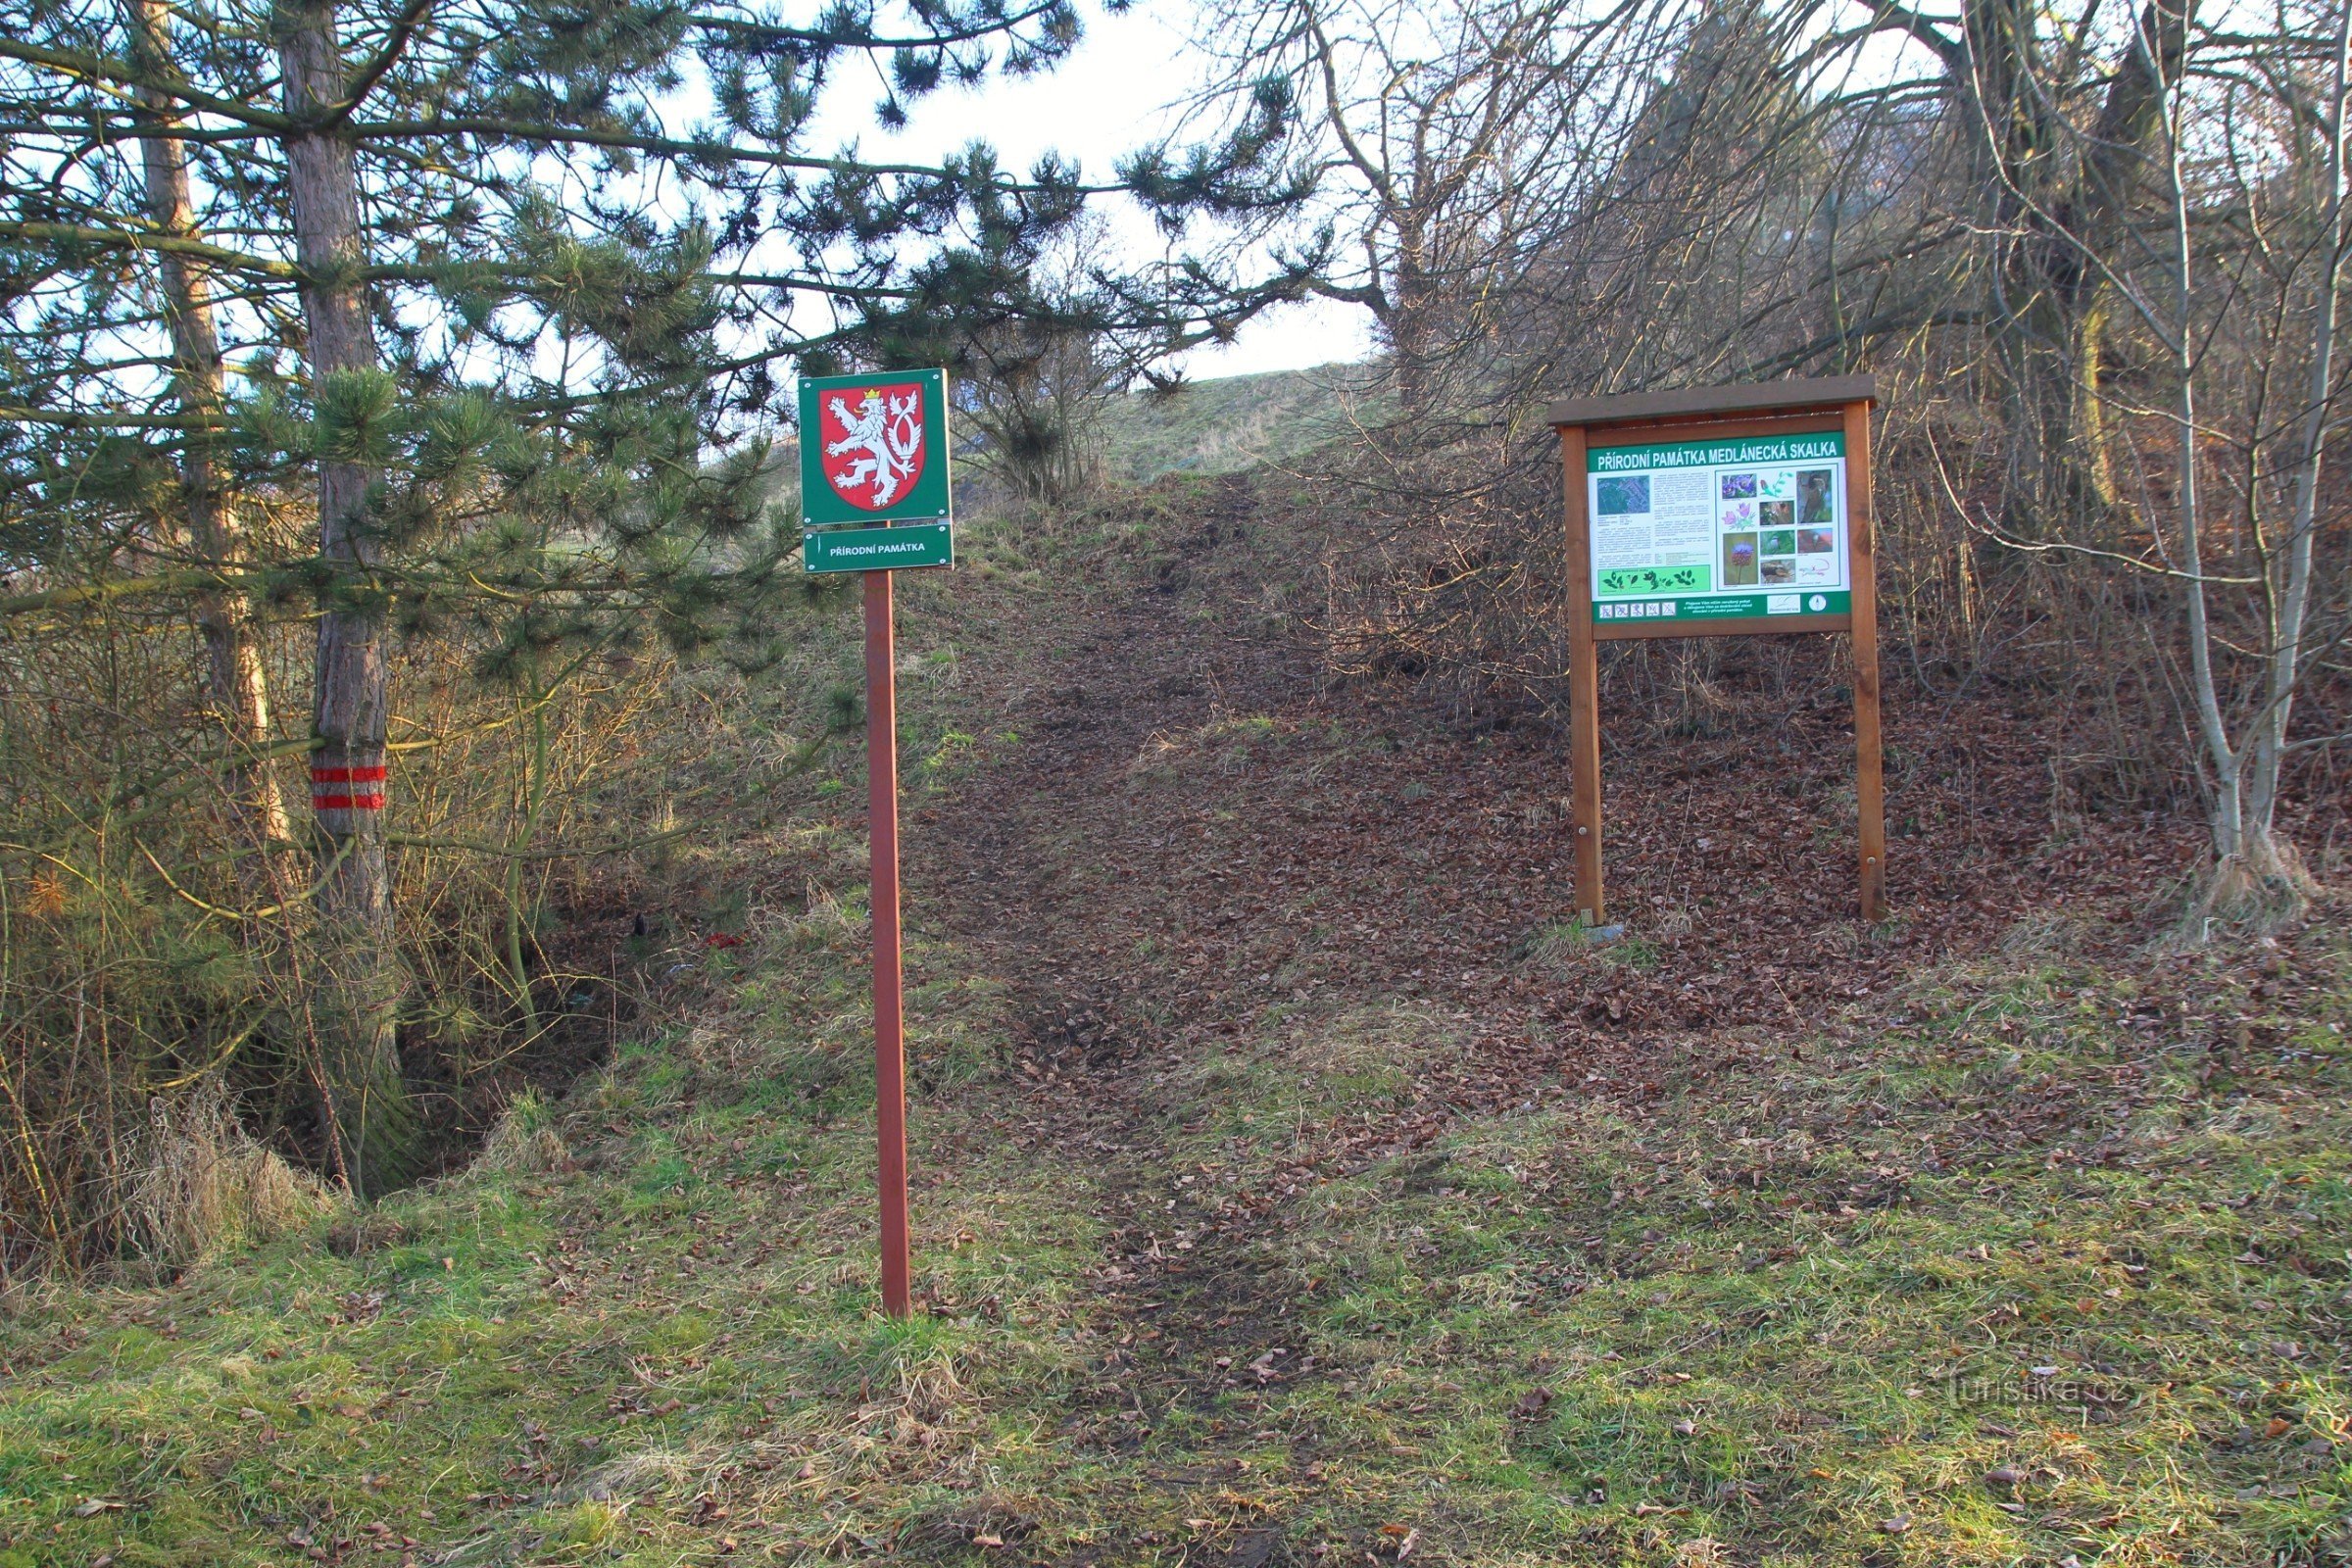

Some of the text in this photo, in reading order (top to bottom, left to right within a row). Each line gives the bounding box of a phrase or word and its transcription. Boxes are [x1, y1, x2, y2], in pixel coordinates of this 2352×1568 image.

[1597, 441, 1838, 470] PŘÍRODNÍ PAMÁTKA MEDLÁNECKÁ SKALKA
[830, 542, 925, 557] PŘÍRODNÍ PAMÁTKA
